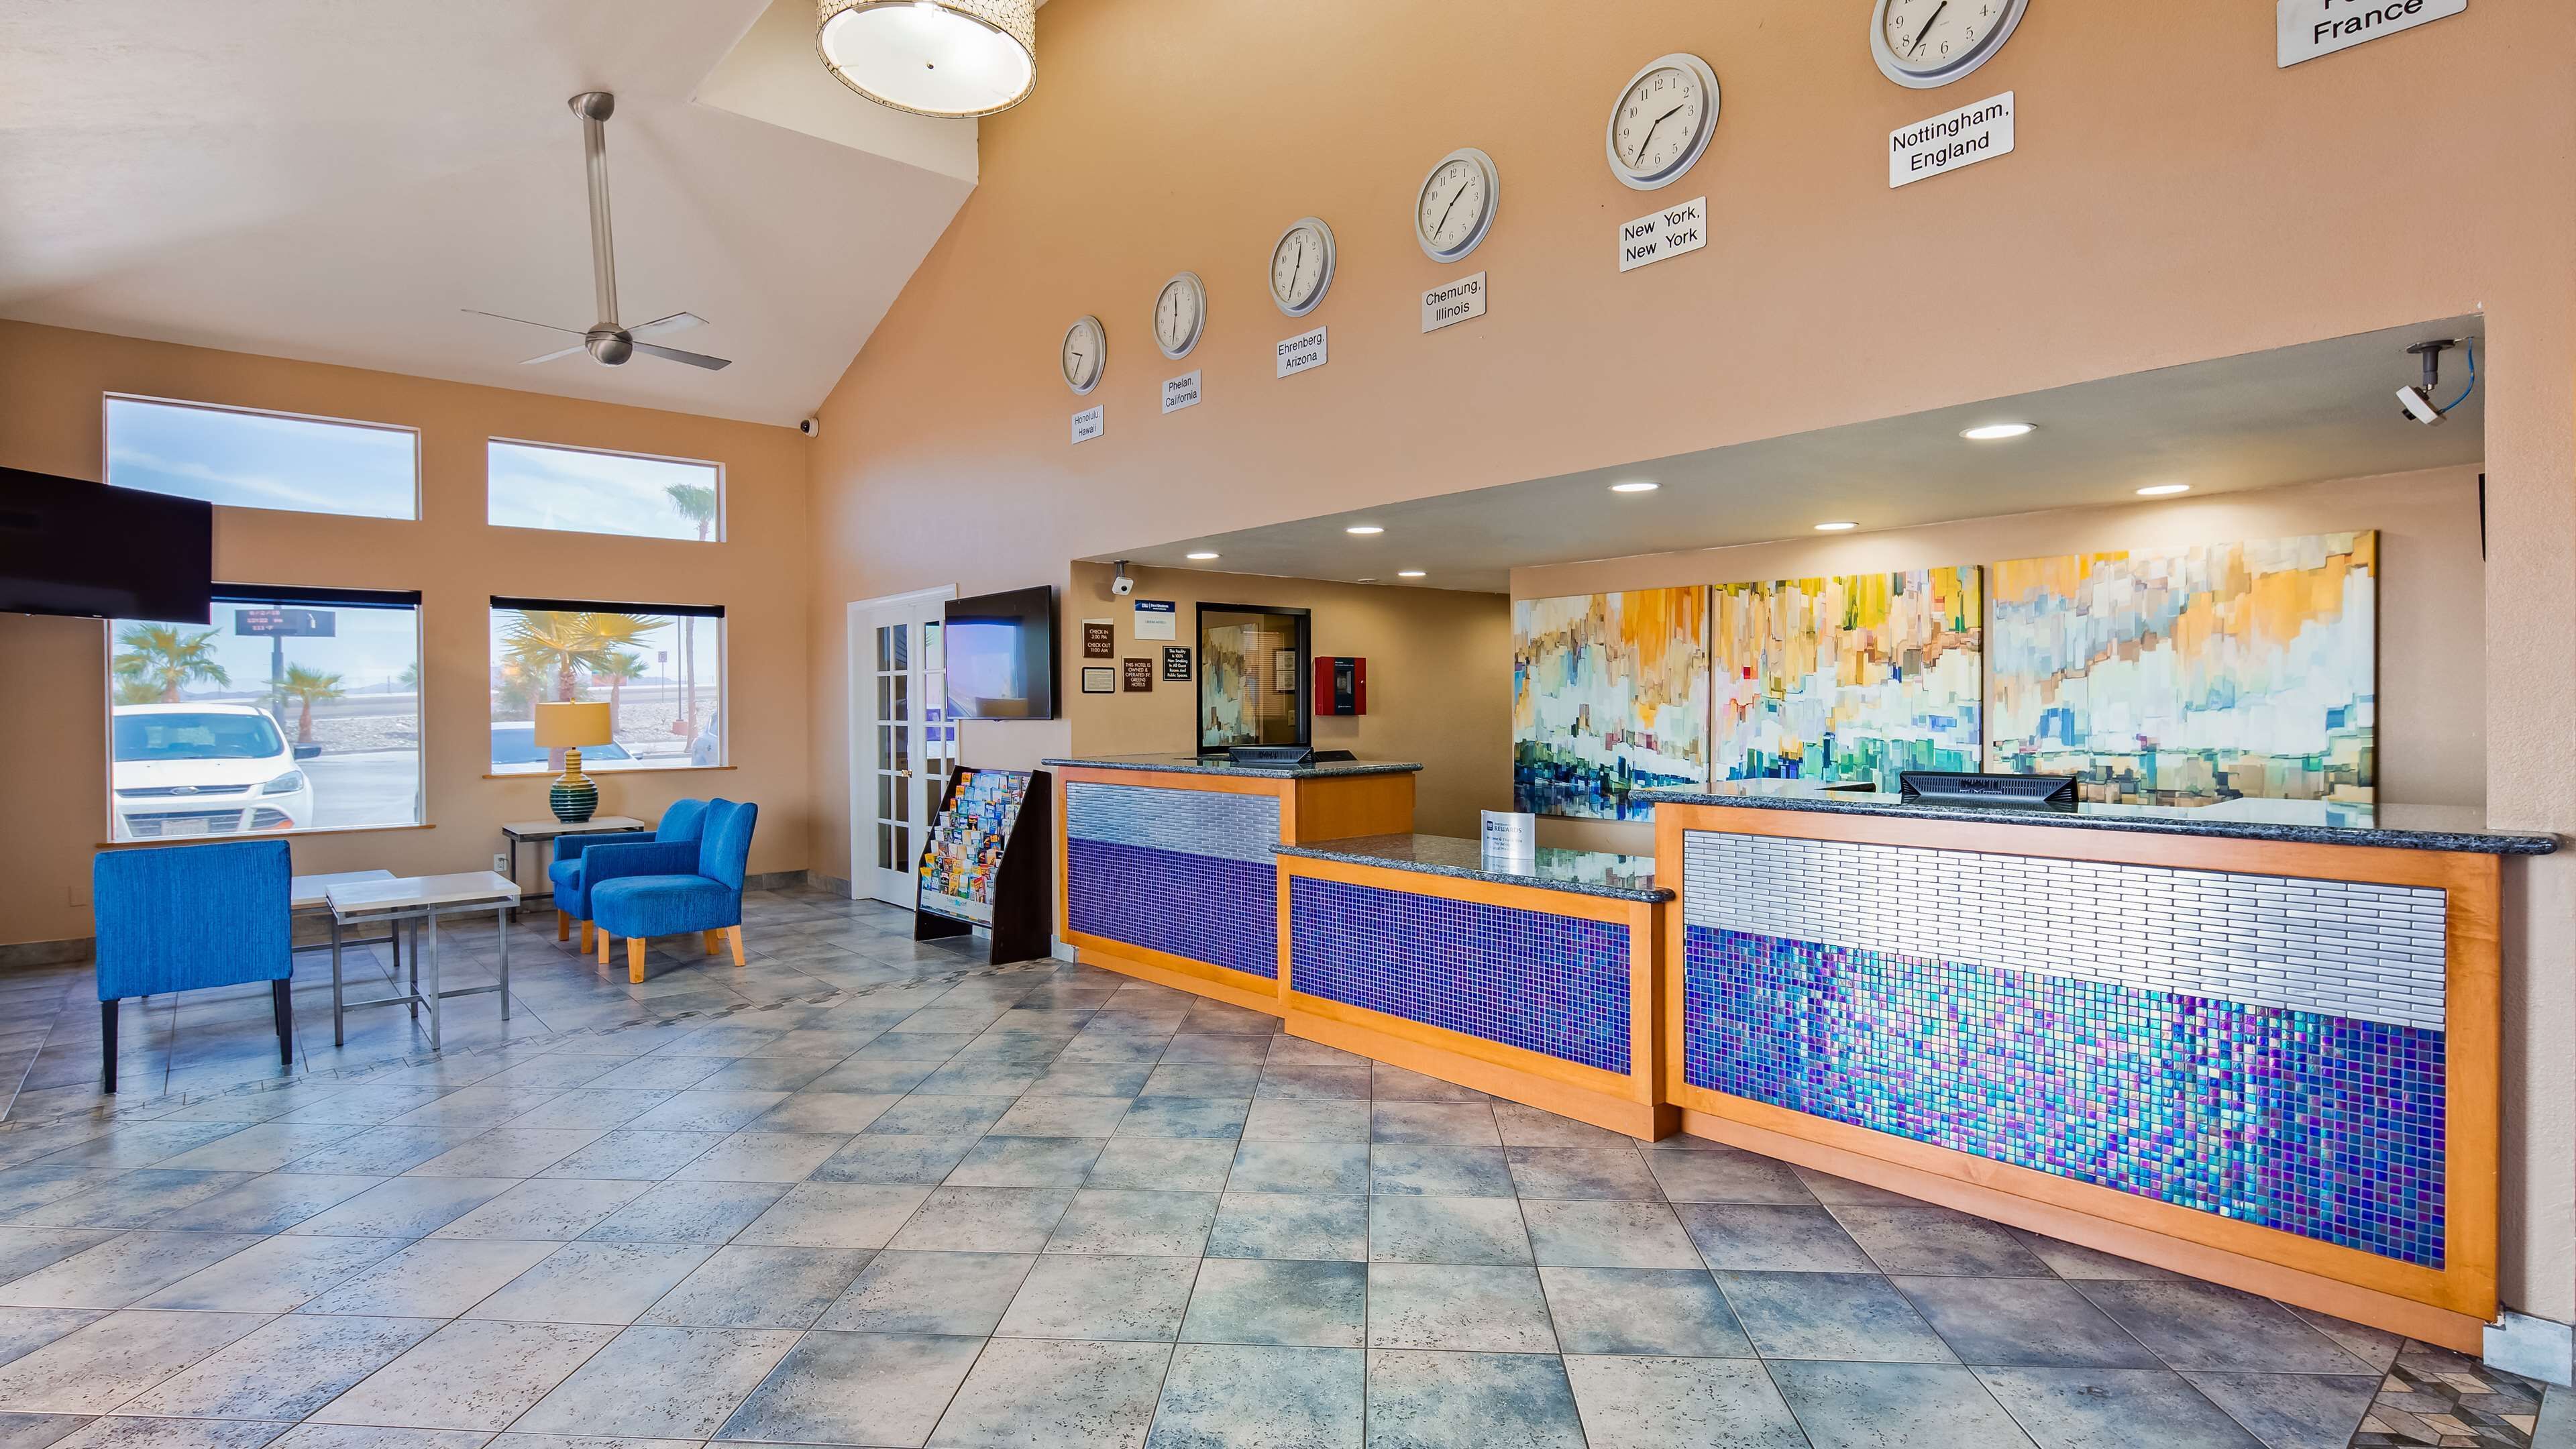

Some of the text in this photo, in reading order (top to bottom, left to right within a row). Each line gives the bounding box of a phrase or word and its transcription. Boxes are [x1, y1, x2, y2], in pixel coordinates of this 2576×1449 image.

[1979, 4, 1989, 17] 4
[1896, 16, 1904, 29] 9
[2314, 0, 2424, 44] France
[1966, 26, 1973, 39] 5
[1902, 34, 1910, 47] 8
[1919, 43, 1927, 56] 7
[1940, 41, 1949, 54] 6
[1654, 78, 1663, 91] 12
[1641, 89, 1648, 101] 11
[1683, 87, 1689, 98] 2
[1630, 106, 1638, 118] 10
[1688, 105, 1694, 116] 3
[1623, 128, 1629, 139] 9
[1682, 126, 1688, 136] 4
[1893, 104, 2009, 152] Nottingham,
[1628, 145, 1633, 155] 8
[1672, 143, 1678, 154] 5
[1911, 130, 1989, 171] England
[1655, 153, 1661, 164] 6
[1450, 168, 1457, 179] 12
[1440, 176, 1446, 187] 11
[1471, 177, 1476, 186] 2
[1431, 191, 1438, 201] 10
[1474, 192, 1479, 201] 3
[1427, 209, 1431, 218] 9
[1469, 209, 1474, 218] 4
[1430, 223, 1434, 232] 8
[1462, 223, 1466, 232] 5
[1625, 206, 1700, 241] New York,
[1295, 235, 1301, 245] 12
[1449, 231, 1453, 240] 6
[1288, 242, 1292, 252] 11
[1626, 228, 1697, 262] New York
[1426, 281, 1481, 306] Chemung,
[1437, 302, 1469, 321] Illinois
[1279, 333, 1325, 356] Ehrenberg,
[1286, 352, 1317, 369] Arizona
[1169, 378, 1194, 392] Phelan,
[1166, 390, 1197, 407] California
[1075, 410, 1100, 424] Honolulu,
[1078, 424, 1096, 437] Hawaii
